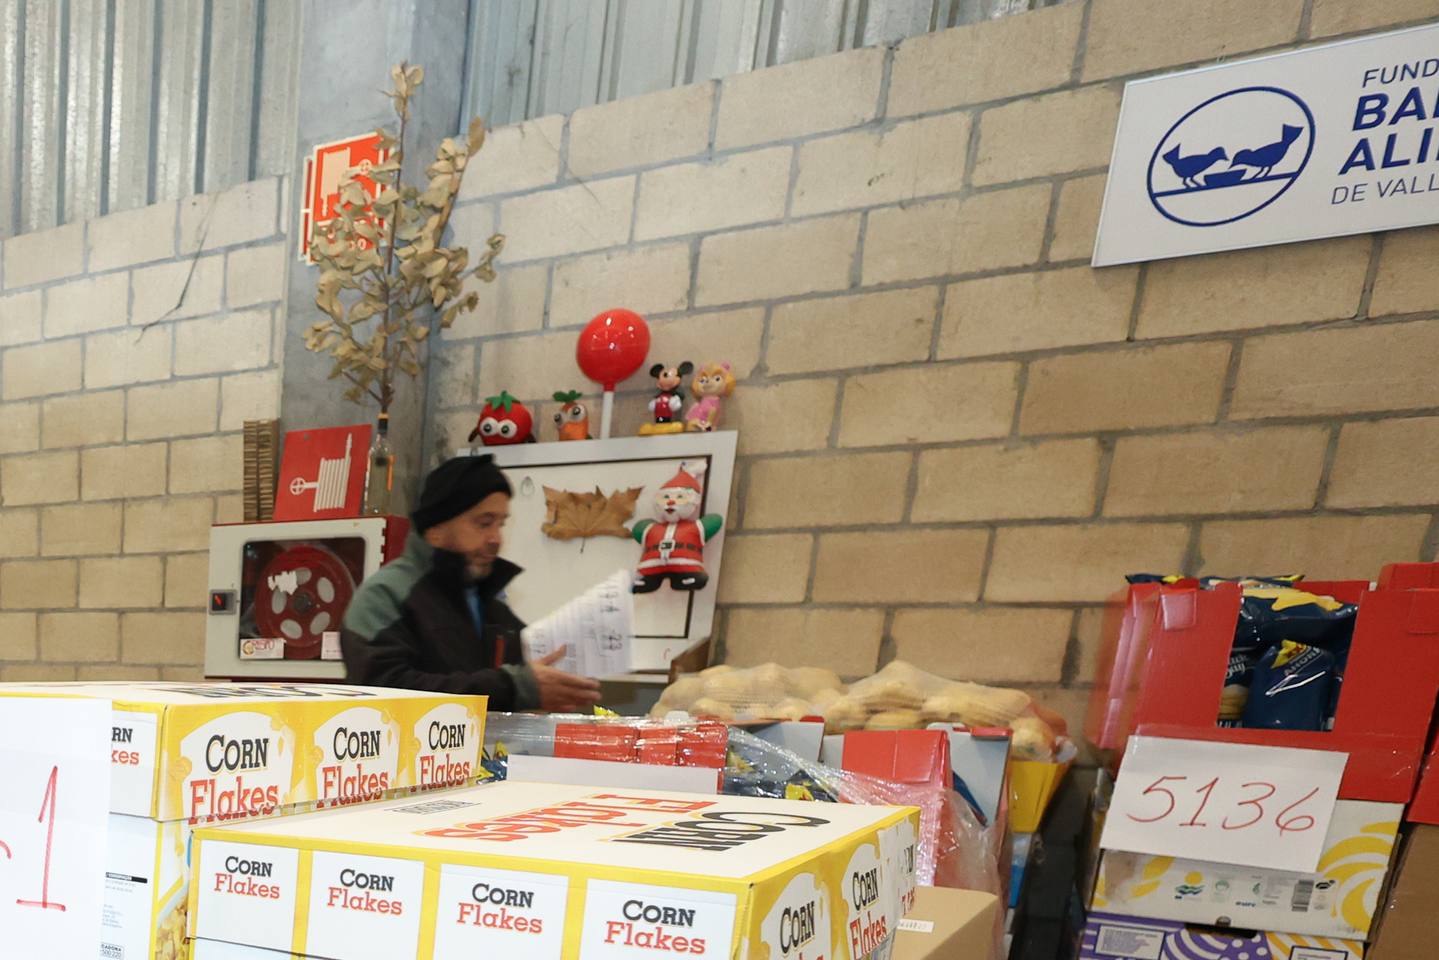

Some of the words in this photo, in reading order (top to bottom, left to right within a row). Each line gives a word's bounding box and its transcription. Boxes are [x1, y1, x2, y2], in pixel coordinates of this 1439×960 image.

[1351, 82, 1439, 132] BA
[1338, 126, 1439, 176] ALI
[1331, 183, 1367, 205] DE
[112, 726, 133, 743] RN
[334, 726, 381, 761] CORN
[428, 720, 465, 751] CORN
[111, 749, 140, 765] kes
[206, 734, 269, 773] CORN
[316, 763, 389, 808] Flakes
[410, 753, 471, 792] Flakes
[188, 777, 279, 825] Flakes
[422, 793, 718, 842] Flakes
[1126, 776, 1319, 836] 5136
[611, 811, 831, 852] CORN
[225, 855, 272, 878] CORN
[339, 868, 395, 892] CORN
[213, 872, 280, 899] Flakes
[327, 886, 403, 917] Flakes
[472, 883, 534, 909] CORN
[852, 867, 879, 911] CORN
[456, 902, 543, 935] Flakes
[622, 899, 696, 928] CORN
[780, 900, 816, 954] CORN
[603, 921, 706, 956] Flakes
[849, 911, 886, 959] Flakes
